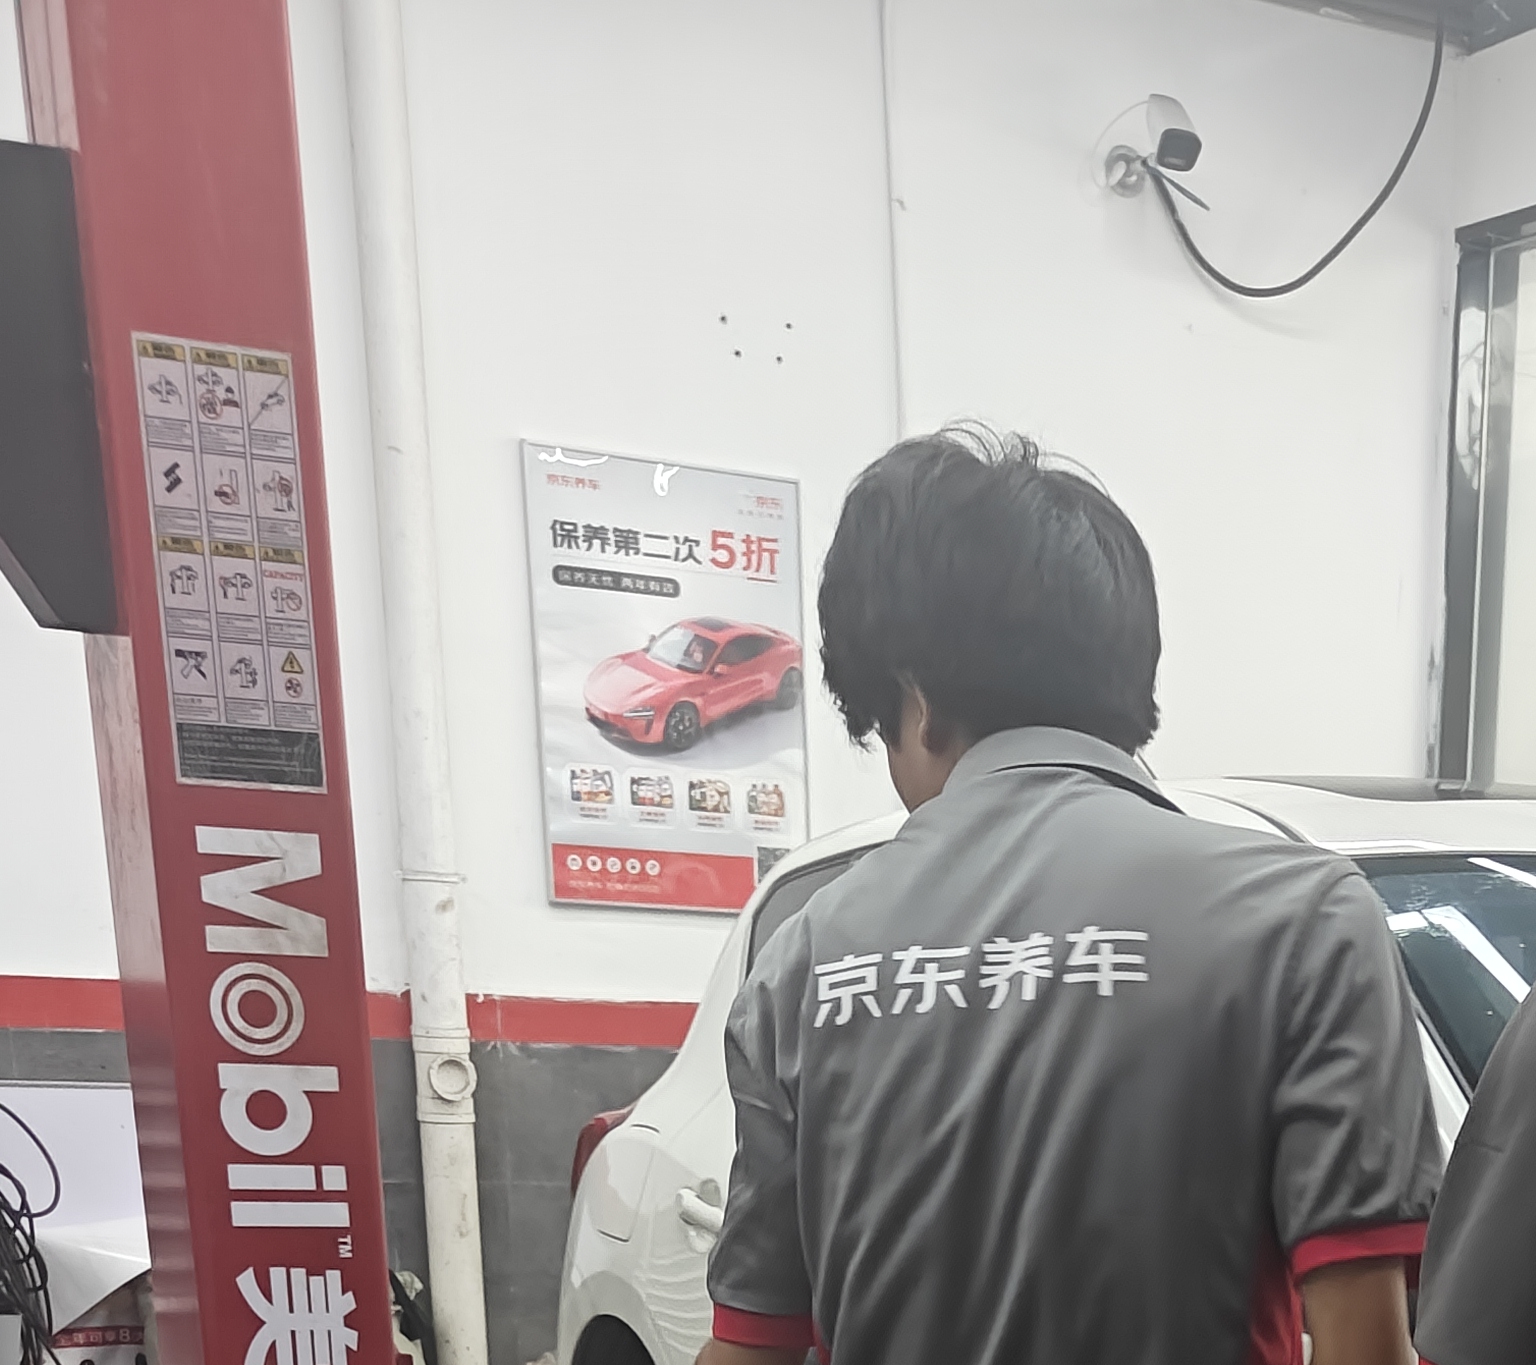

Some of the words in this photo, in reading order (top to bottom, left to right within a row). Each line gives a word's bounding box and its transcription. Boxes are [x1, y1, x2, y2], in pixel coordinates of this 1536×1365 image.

[194, 824, 351, 1228] Mobil
[813, 925, 1149, 1029] 京东养车
